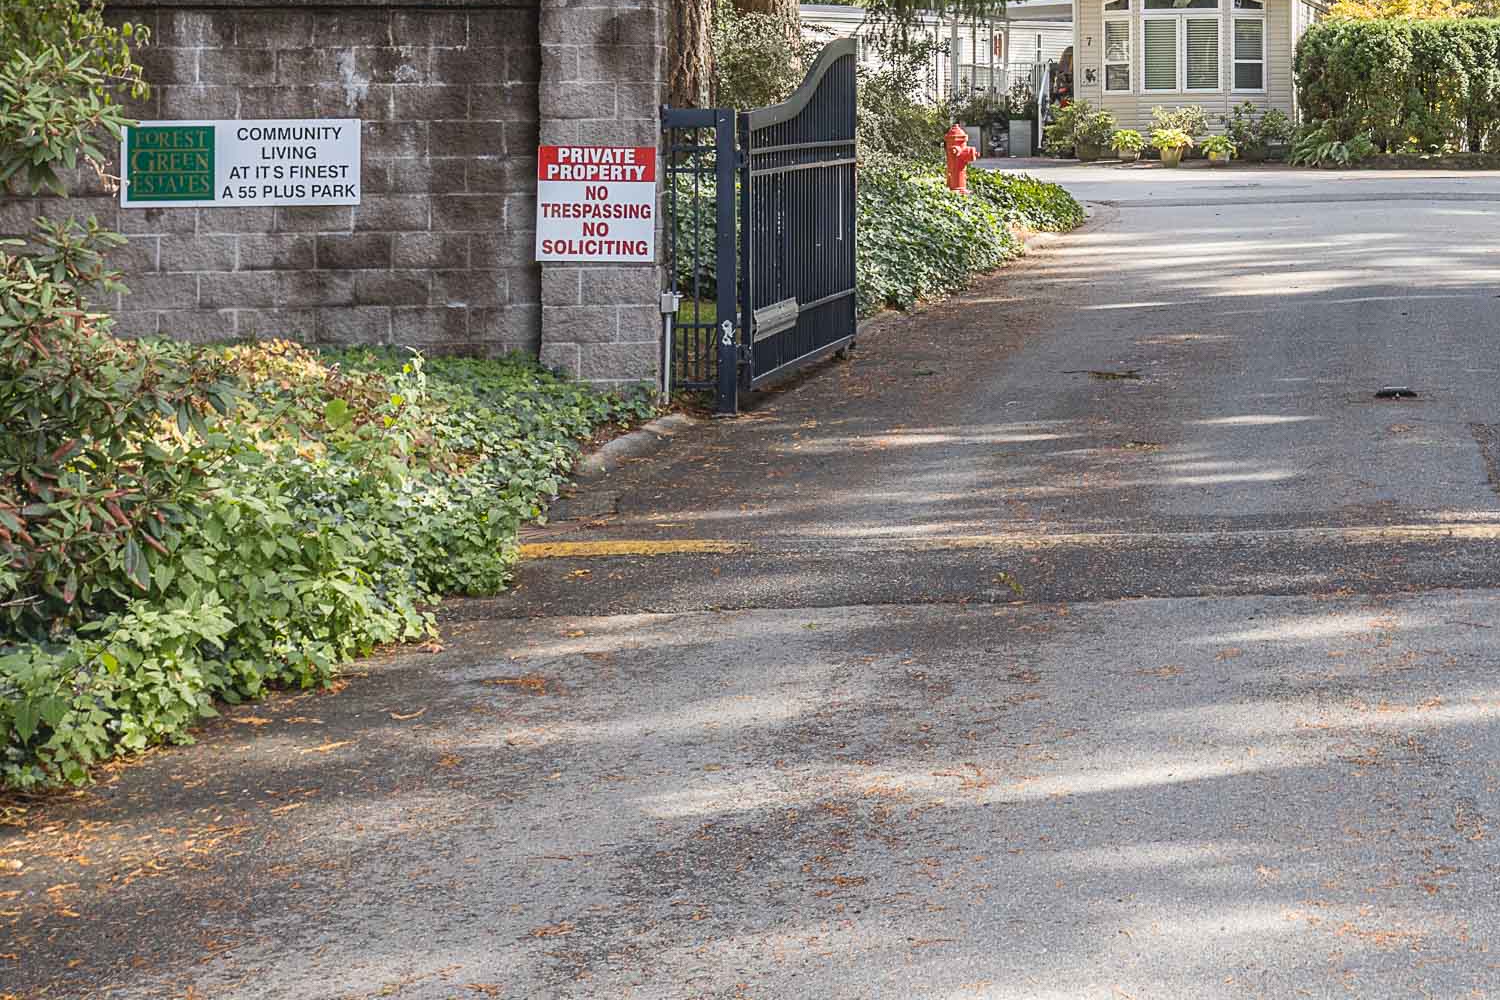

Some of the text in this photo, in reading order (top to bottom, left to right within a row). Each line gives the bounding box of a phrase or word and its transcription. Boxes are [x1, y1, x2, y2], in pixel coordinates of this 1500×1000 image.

[135, 130, 208, 148] FOREST
[236, 127, 342, 141] COMMUNITY
[261, 146, 317, 160] LIVING
[557, 147, 636, 164] PRIVATE
[130, 150, 209, 173] GREEN
[229, 166, 250, 180] AT
[290, 165, 349, 179] FINEST
[547, 164, 647, 181] PROPERTY
[132, 174, 210, 193] ESTATES
[222, 184, 356, 199] A 55 PLUS PARK
[585, 185, 609, 201] NO
[541, 203, 651, 219] TRESPASSING
[582, 222, 609, 237] NO
[541, 239, 649, 256] SOLICITING
